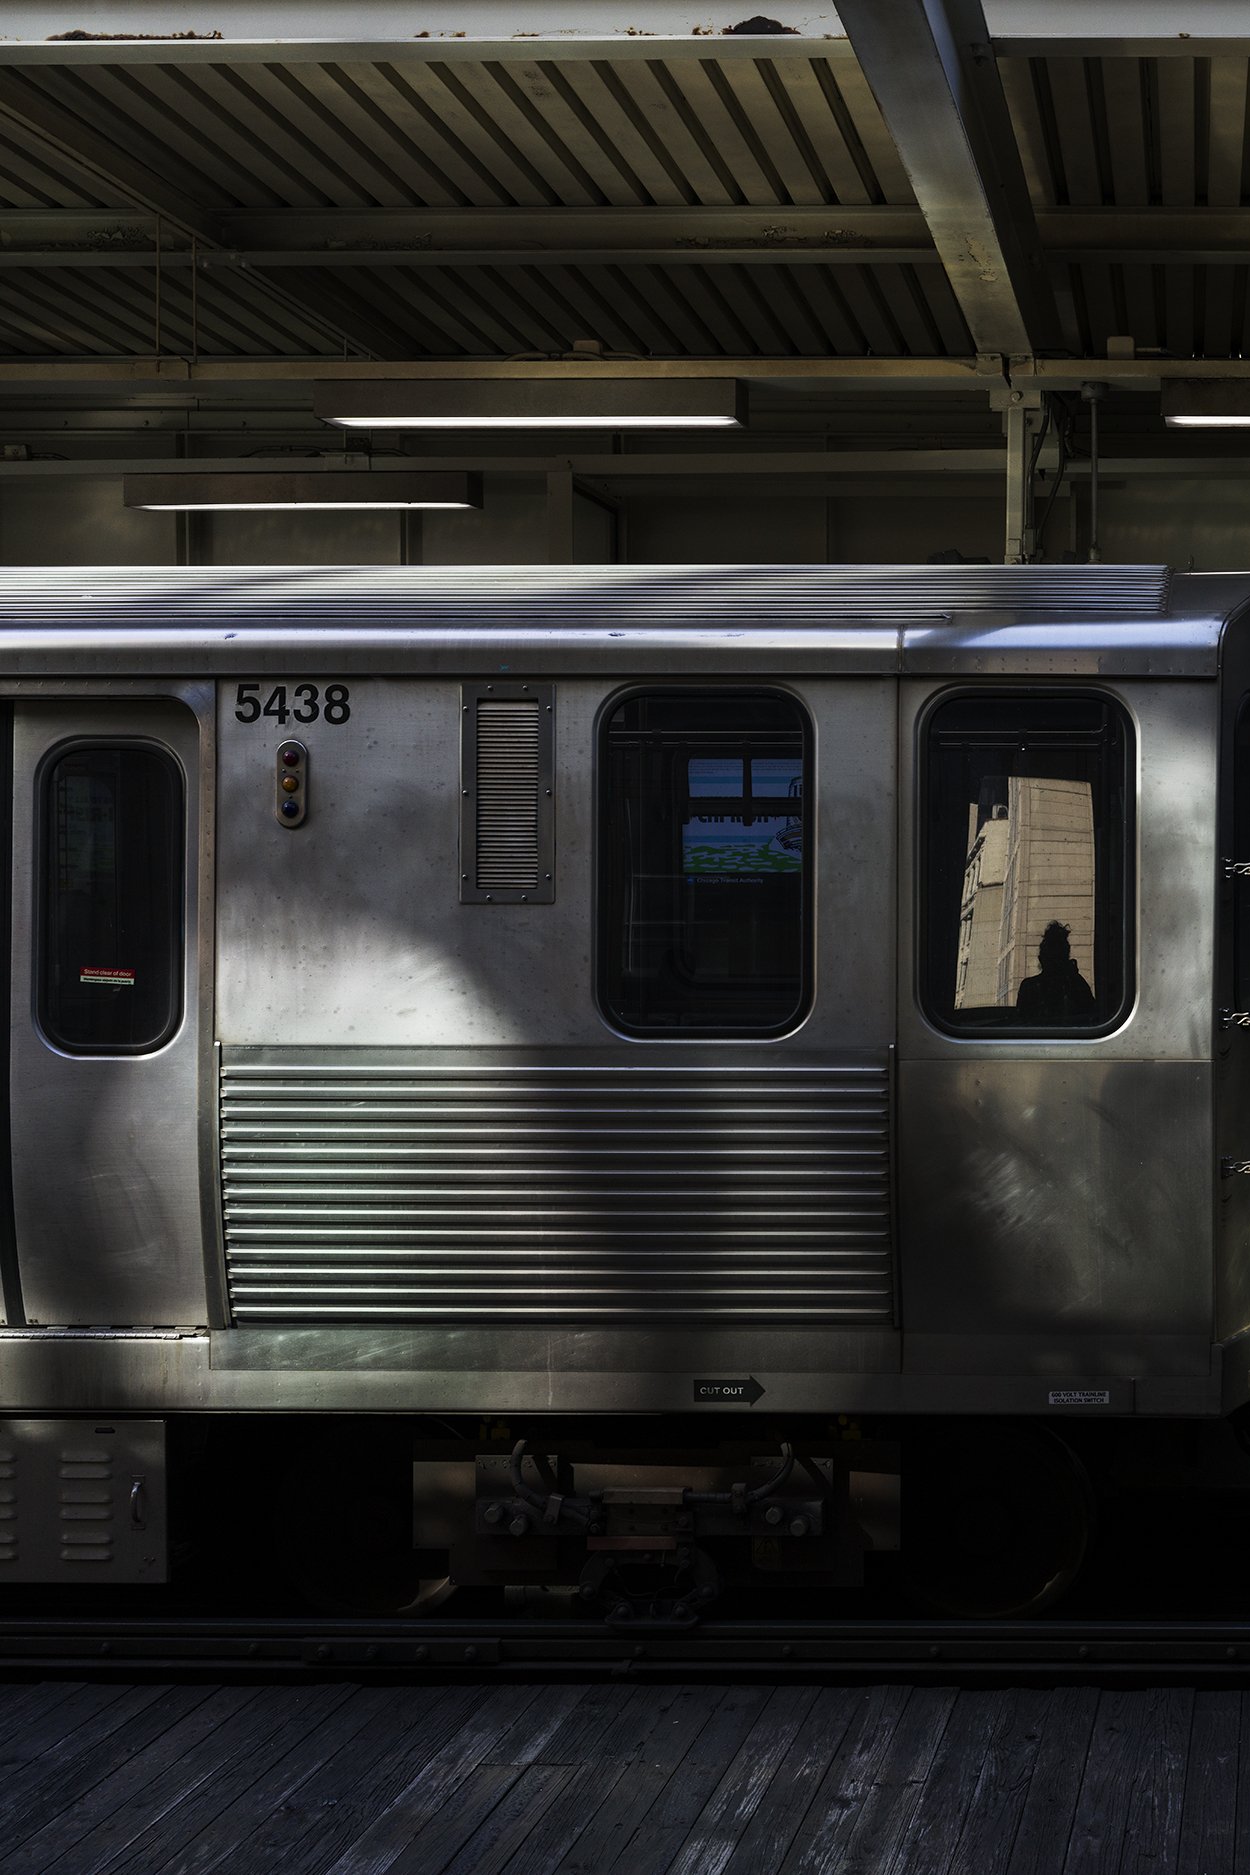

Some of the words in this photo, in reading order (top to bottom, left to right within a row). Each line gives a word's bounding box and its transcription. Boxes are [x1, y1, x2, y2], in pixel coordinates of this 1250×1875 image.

[235, 683, 351, 725] 5438
[699, 1386, 721, 1395] CUT
[722, 1386, 744, 1395] OUT
